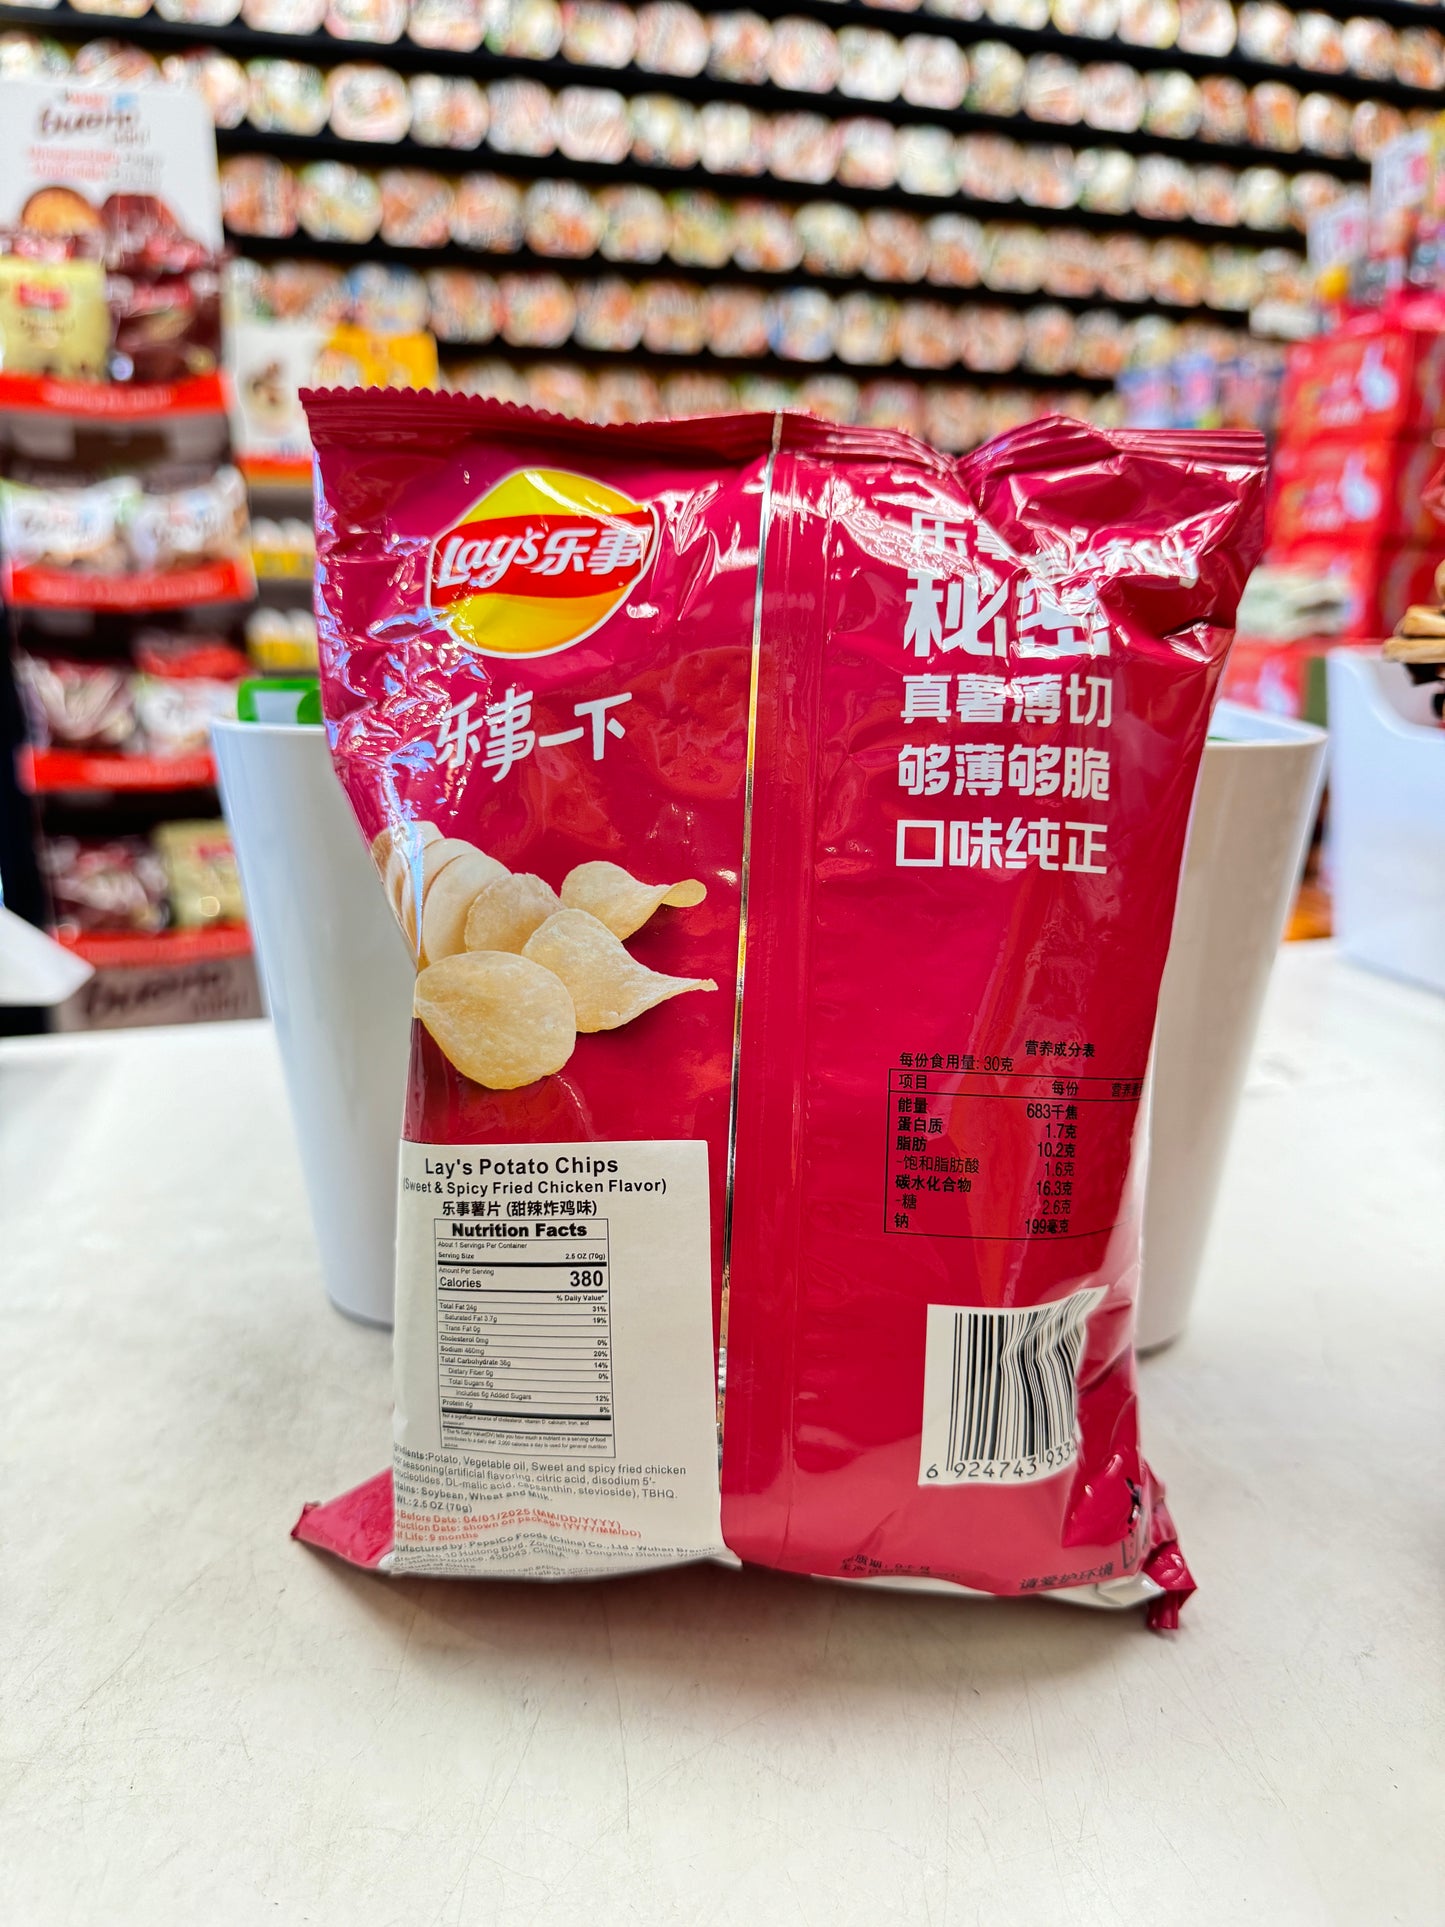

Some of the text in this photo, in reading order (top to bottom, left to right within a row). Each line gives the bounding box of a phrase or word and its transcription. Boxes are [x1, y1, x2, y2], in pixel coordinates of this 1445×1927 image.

[436, 526, 546, 589] Lay's
[532, 527, 644, 577] 乐事
[900, 673, 1113, 729] 真薯薄切
[435, 687, 633, 783] 乐事一下
[898, 743, 1111, 802] 够薄够脆
[895, 816, 1109, 875] 口味纯正
[1025, 1040, 1096, 1059] 营养成分表
[983, 1056, 1015, 1073] 30克
[898, 1074, 928, 1090] 项目
[1052, 1081, 1080, 1097] 每份
[897, 1097, 928, 1115] 能量
[1026, 1103, 1079, 1121] 683千焦
[897, 1117, 944, 1134] 蛋白质
[1045, 1123, 1078, 1140] 1.7克
[895, 1136, 928, 1152] 脂肪
[1038, 1142, 1076, 1159] 10.2克
[425, 1156, 619, 1179] Lay's Potato Chips
[1045, 1161, 1075, 1178] 1.6克
[403, 1177, 667, 1198] (Sweet & Spicy Fried Chicken Flavor)
[895, 1175, 972, 1193] 碳水化合物
[1036, 1180, 1073, 1197] 16.3克
[442, 1200, 598, 1217] 乐事薯片 (甜辣炸鸡味)
[1042, 1199, 1072, 1215] 2.6克
[894, 1213, 909, 1229] 钠
[1025, 1218, 1070, 1235] 199毫克
[452, 1222, 588, 1238] Nutrition Facts
[459, 1242, 485, 1250] Servings
[588, 1252, 606, 1260] (70g)
[472, 1268, 495, 1276] Serving
[570, 1270, 604, 1287] 380
[440, 1276, 482, 1288] Calories
[457, 1357, 498, 1366] Carbohydrate
[442, 1399, 464, 1407] Protein
[463, 1456, 511, 1470] Vegetable
[513, 1461, 529, 1471] oil,
[531, 1462, 564, 1472] Sweet
[566, 1463, 586, 1472] and
[588, 1464, 616, 1475] spicy
[618, 1464, 642, 1474] fried
[645, 1464, 687, 1475] chicken
[926, 1463, 939, 1479] 6
[953, 1457, 1038, 1479] 924743
[536, 1474, 562, 1483] citric
[564, 1475, 590, 1485] acid,
[592, 1476, 640, 1486] disodium
[421, 1487, 467, 1501] Soybean,
[469, 1492, 503, 1501] Wheat
[506, 1490, 526, 1498] and
[642, 1488, 678, 1499] TBHQ.
[430, 1501, 444, 1510] OZ
[446, 1502, 473, 1513] (70g)
[400, 1509, 431, 1522] Before
[433, 1514, 461, 1524] Date:
[433, 1524, 460, 1532] Date:
[502, 1517, 515, 1526] on
[438, 1532, 479, 1541] months
